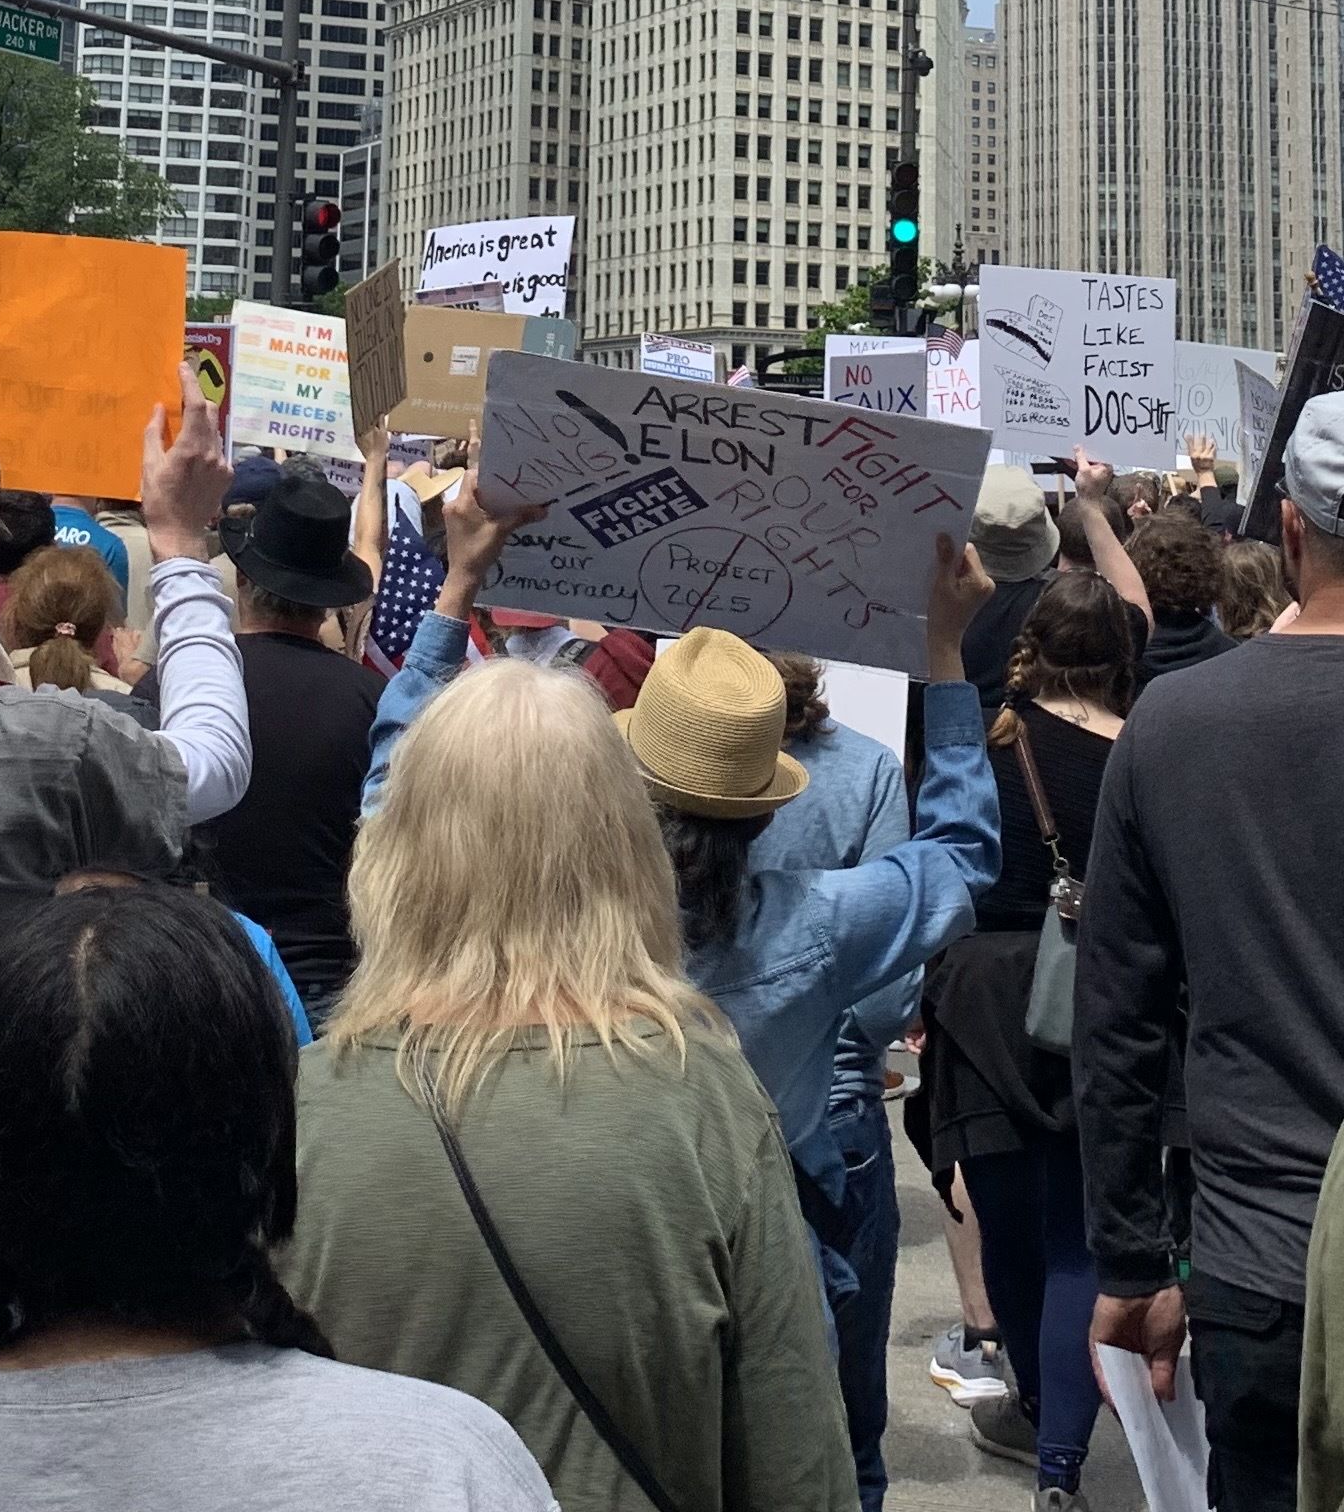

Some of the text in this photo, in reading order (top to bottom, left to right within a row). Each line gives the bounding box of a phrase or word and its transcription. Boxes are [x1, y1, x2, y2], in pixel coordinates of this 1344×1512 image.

[5, 34, 36, 52] 240 N
[46, 25, 59, 40] DR
[423, 225, 558, 271] America is great
[1081, 279, 1164, 313] TASTES
[305, 325, 333, 341] I'M
[1083, 322, 1145, 346] LIKE
[295, 363, 332, 381] FOR
[666, 352, 691, 366] PRO
[1084, 354, 1154, 377] FACIST
[845, 364, 873, 387] NO
[296, 383, 323, 400] MY
[492, 402, 581, 445] NO
[632, 385, 831, 446] ARREST
[1084, 384, 1175, 441] DOGSHIT
[268, 420, 336, 444] RIGHTS
[387, 442, 427, 457] orkers
[640, 423, 775, 476] ELON
[815, 416, 963, 515] FIGHT
[581, 475, 685, 530] FIGHT
[822, 466, 879, 516] FOR
[603, 495, 698, 544] HATE
[772, 475, 882, 569] OUR
[53, 526, 91, 546] ARO
[550, 554, 594, 570] our
[668, 543, 777, 585] PROJECT
[663, 584, 752, 613] 2025
